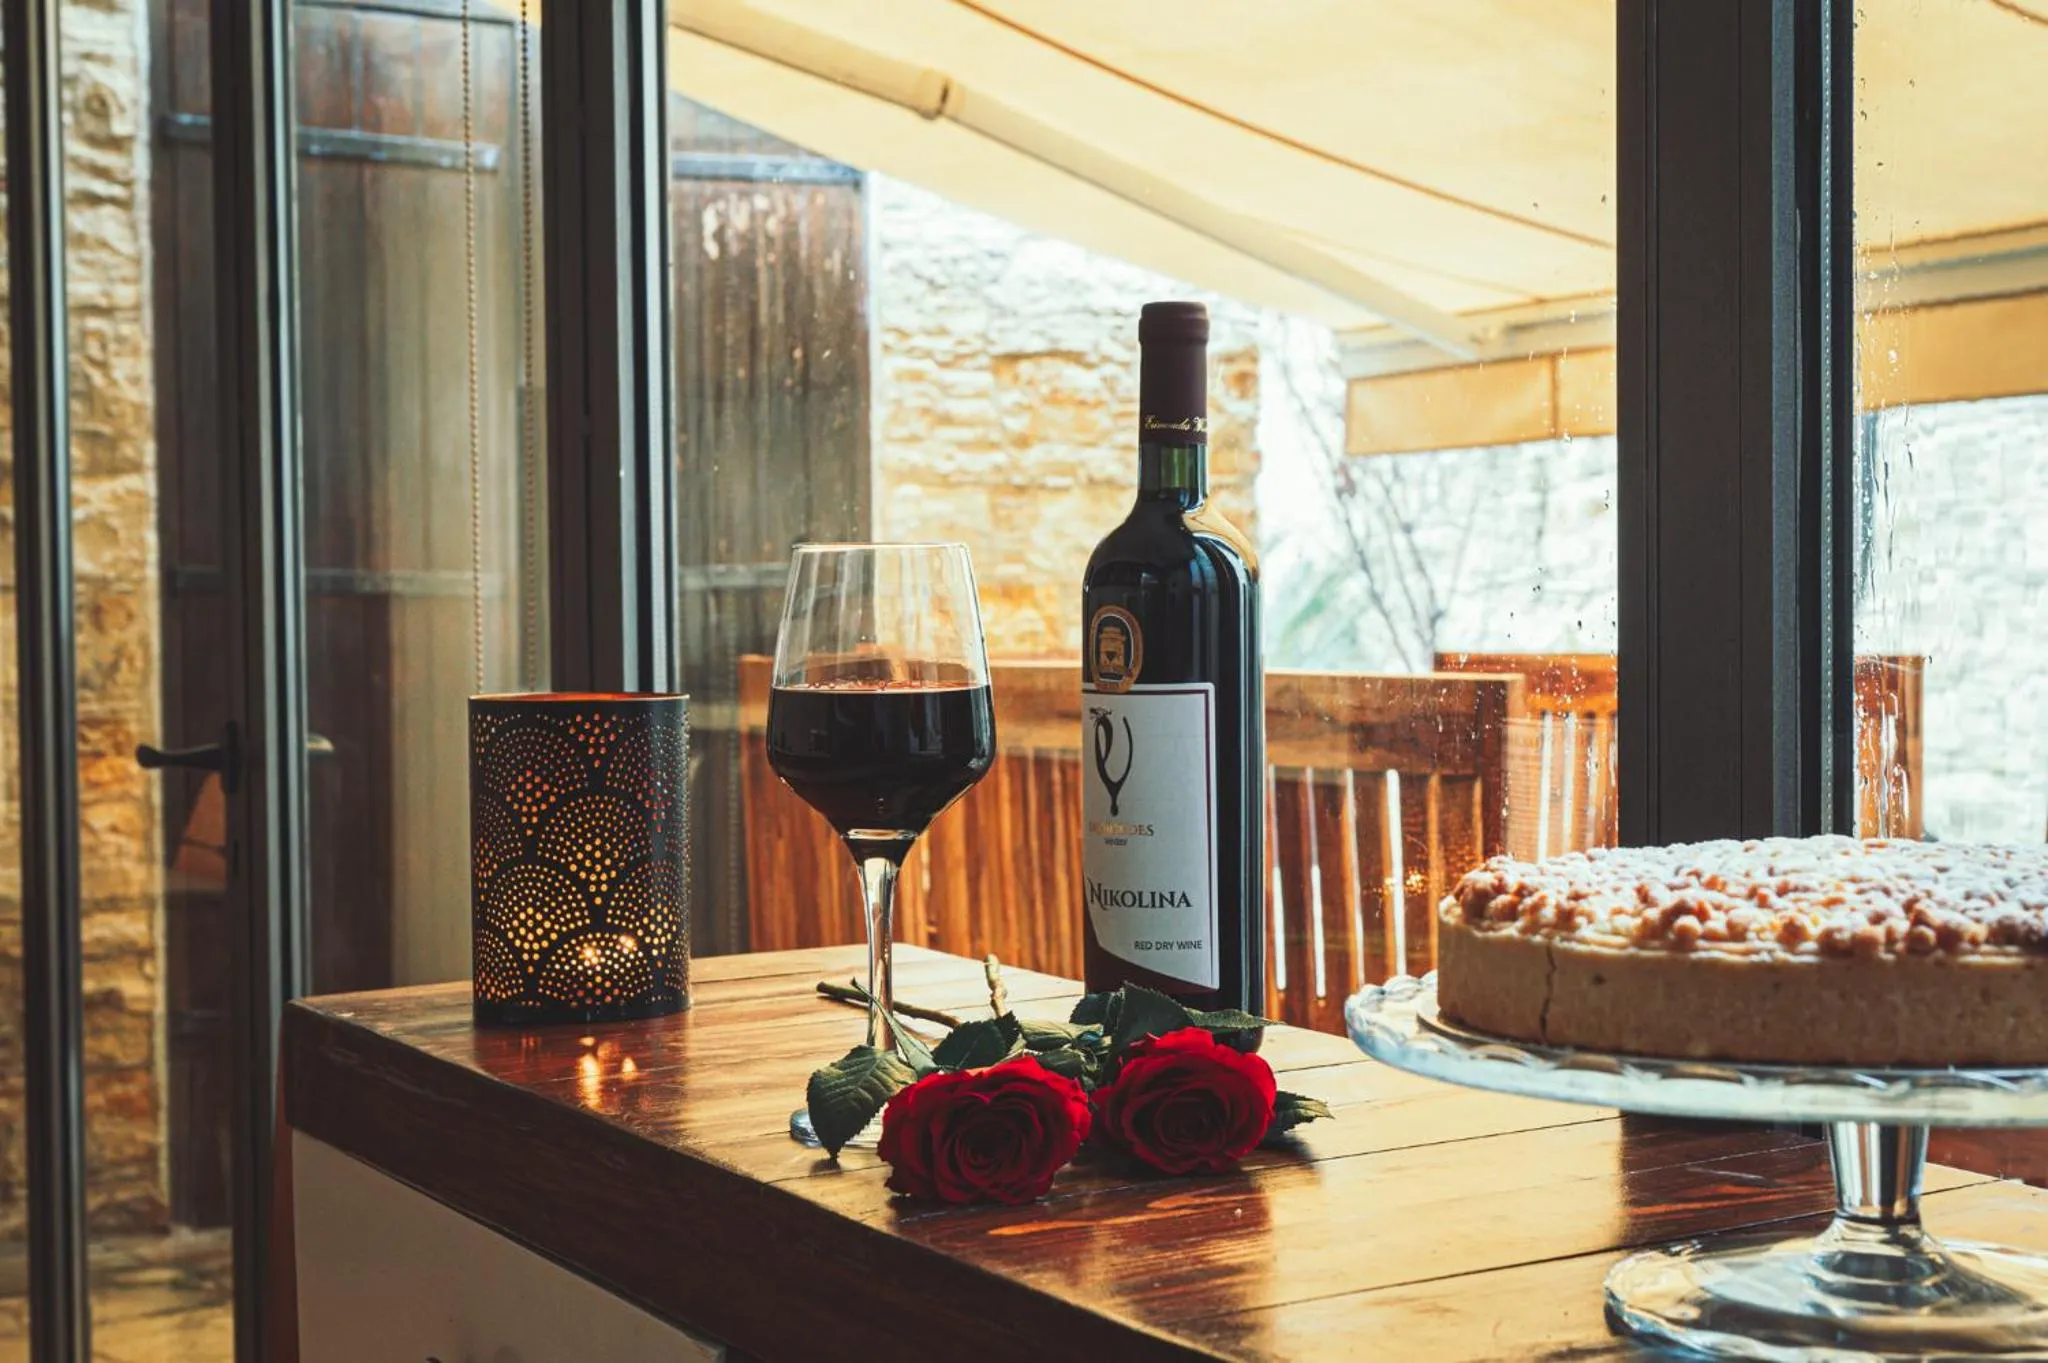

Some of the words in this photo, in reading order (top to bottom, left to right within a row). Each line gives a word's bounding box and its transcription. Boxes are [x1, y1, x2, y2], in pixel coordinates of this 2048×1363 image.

[1087, 876, 1193, 911] NIKOLINA
[1134, 940, 1153, 950] RED
[1155, 940, 1174, 951] DRY
[1176, 939, 1203, 950] WINE
